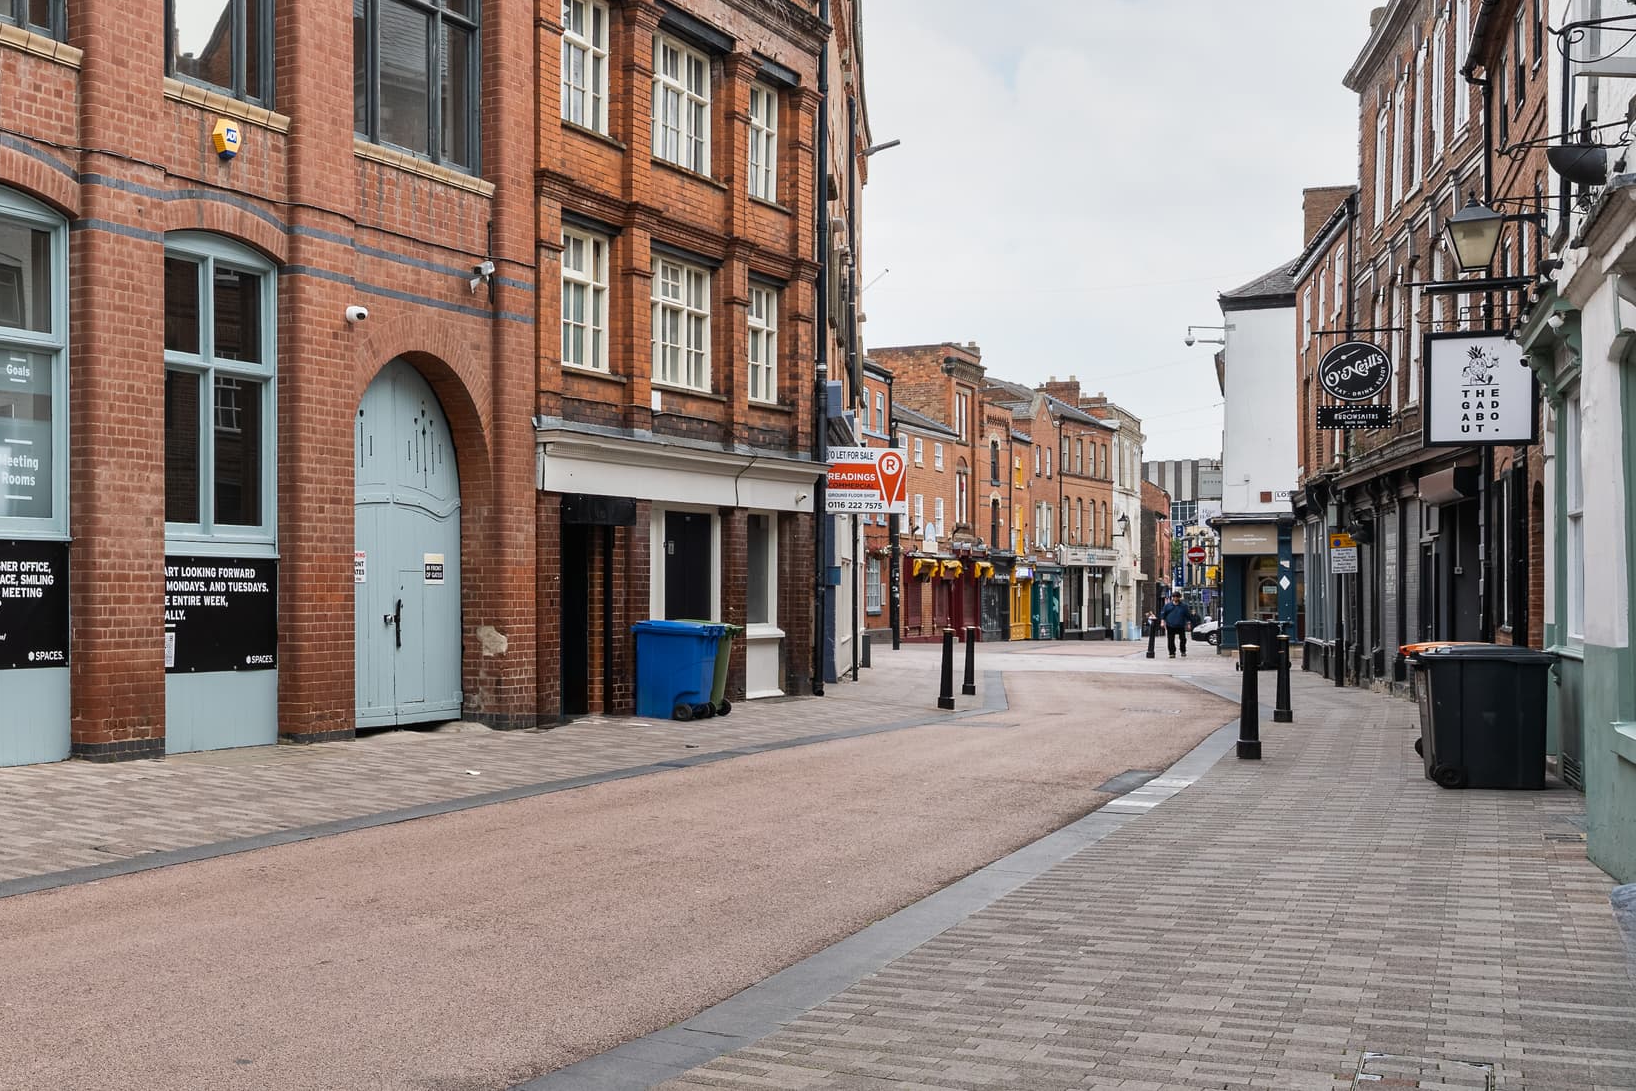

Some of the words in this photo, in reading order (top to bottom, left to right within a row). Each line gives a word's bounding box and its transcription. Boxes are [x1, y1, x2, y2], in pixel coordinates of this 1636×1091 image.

[6, 364, 30, 377] Goals
[1325, 353, 1384, 387] O'Neill's
[1461, 389, 1500, 398] THE
[836, 451, 846, 459] LET
[848, 451, 859, 460] FOR
[860, 452, 873, 460] SALE
[1, 472, 36, 486] Rooms
[828, 473, 876, 481] READINGS
[20, 562, 51, 573] OFFICE,
[181, 567, 216, 578] LOOKING
[218, 568, 256, 578] FORWARD
[20, 574, 54, 585] SMILING
[166, 581, 207, 592] MONDAYS.
[209, 582, 226, 592] AND
[228, 582, 269, 592] TUESDAYS.
[2, 587, 43, 598] MEETING
[172, 596, 201, 606] ENTIRE
[204, 596, 228, 607] WEEK,
[165, 610, 186, 620] ALLY.
[35, 651, 64, 660] SPACES.
[251, 655, 273, 664] SPACES.
